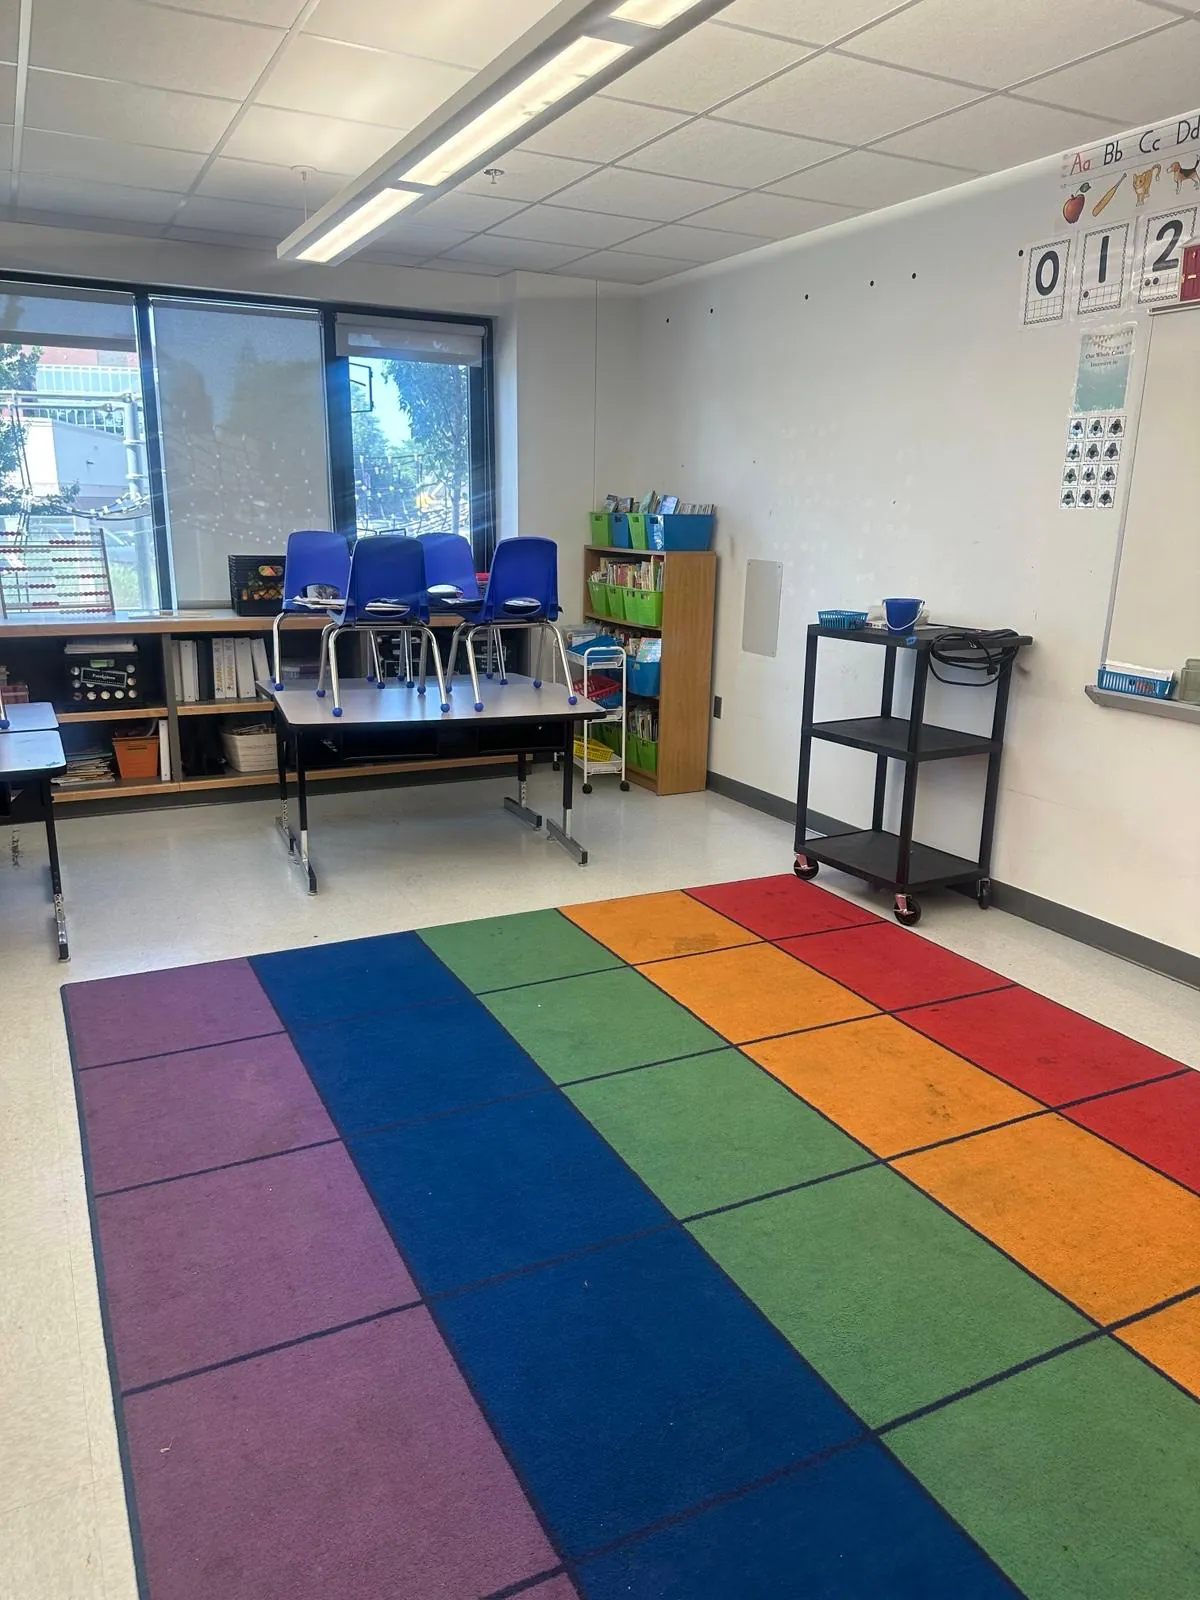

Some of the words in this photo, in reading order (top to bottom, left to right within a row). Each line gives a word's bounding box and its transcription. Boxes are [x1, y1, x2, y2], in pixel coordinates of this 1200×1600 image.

[1070, 152, 1091, 176] Aa
[1103, 141, 1123, 166] Bb
[1138, 130, 1161, 153] Cc
[1177, 115, 1200, 145] Dd
[1098, 235, 1110, 284] 1
[1152, 219, 1184, 272] 2
[1035, 250, 1060, 296] 0
